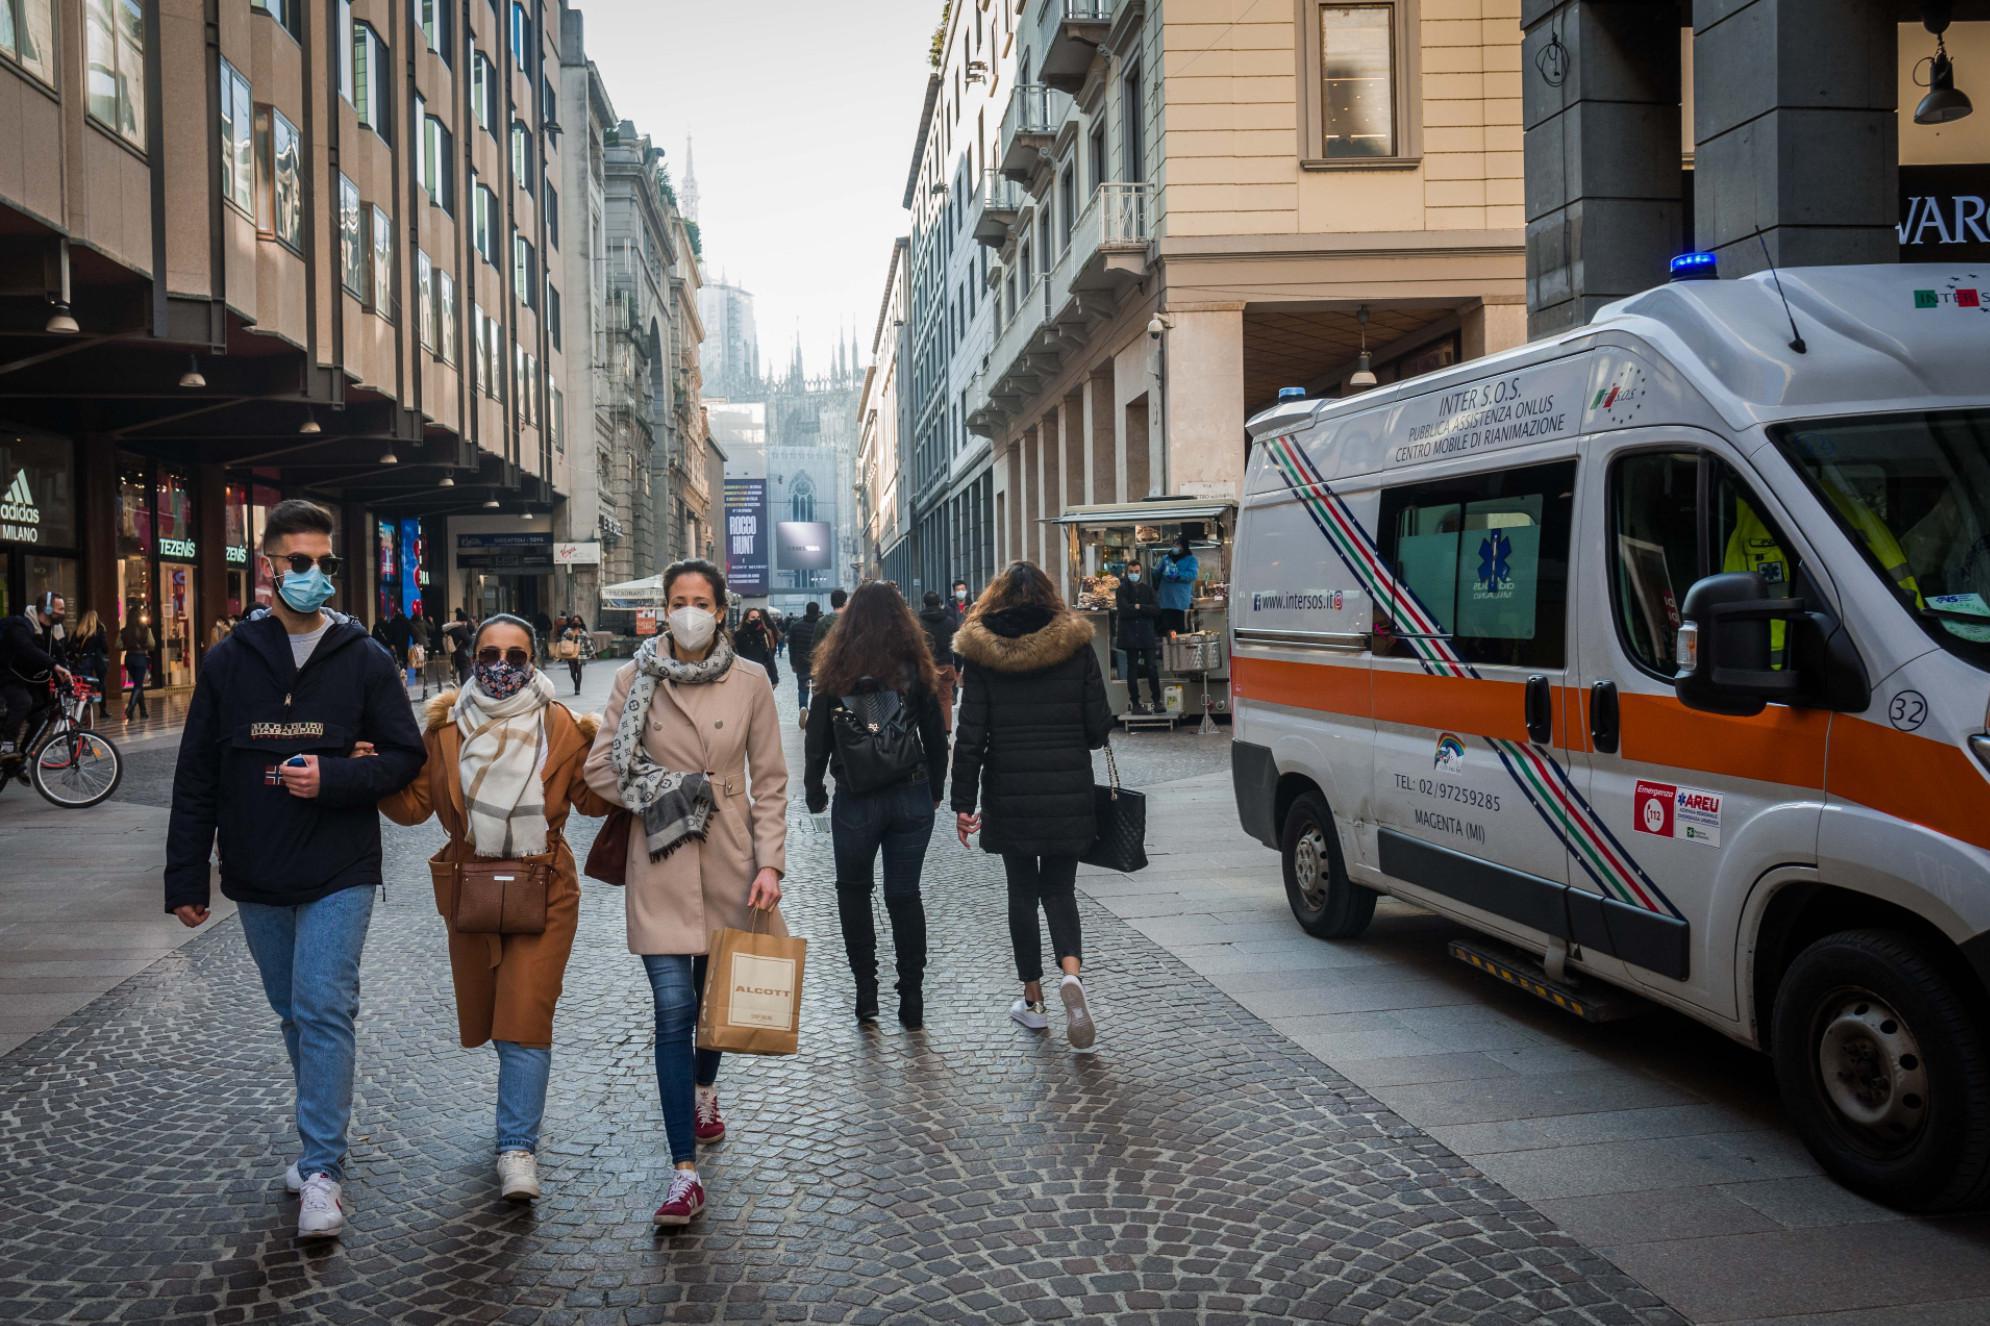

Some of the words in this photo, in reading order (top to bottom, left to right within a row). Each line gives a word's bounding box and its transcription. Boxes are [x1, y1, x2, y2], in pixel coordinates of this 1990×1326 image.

[1438, 388, 1477, 417] INTER
[1480, 377, 1522, 408] S.O.S.
[1408, 418, 1450, 443] PUBBLICA
[1452, 408, 1512, 432] ASSISTENZA
[1515, 395, 1553, 417] ONLUS
[1395, 442, 1431, 463] CENTRO
[1432, 434, 1468, 456] MOBILE
[1470, 433, 1481, 449] DI
[1483, 413, 1566, 446] RIANIMAZIONE
[1, 502, 40, 524] adidas
[2, 524, 38, 543] MILANO
[729, 515, 757, 535] ROCCO
[159, 538, 196, 558] TEZENIS
[733, 535, 754, 555] HUNT
[1262, 590, 1333, 610] www.intersos.it
[1892, 698, 1923, 724] 32
[1394, 773, 1416, 791] TEL:
[1419, 779, 1501, 812] 02/97259285
[1637, 784, 1674, 798] Emergenza
[1685, 793, 1720, 813] AREU
[1649, 809, 1661, 821] 112
[1415, 808, 1463, 836] MAGENTA
[1465, 822, 1486, 844] (MI)
[735, 985, 792, 997] ALCOTT
